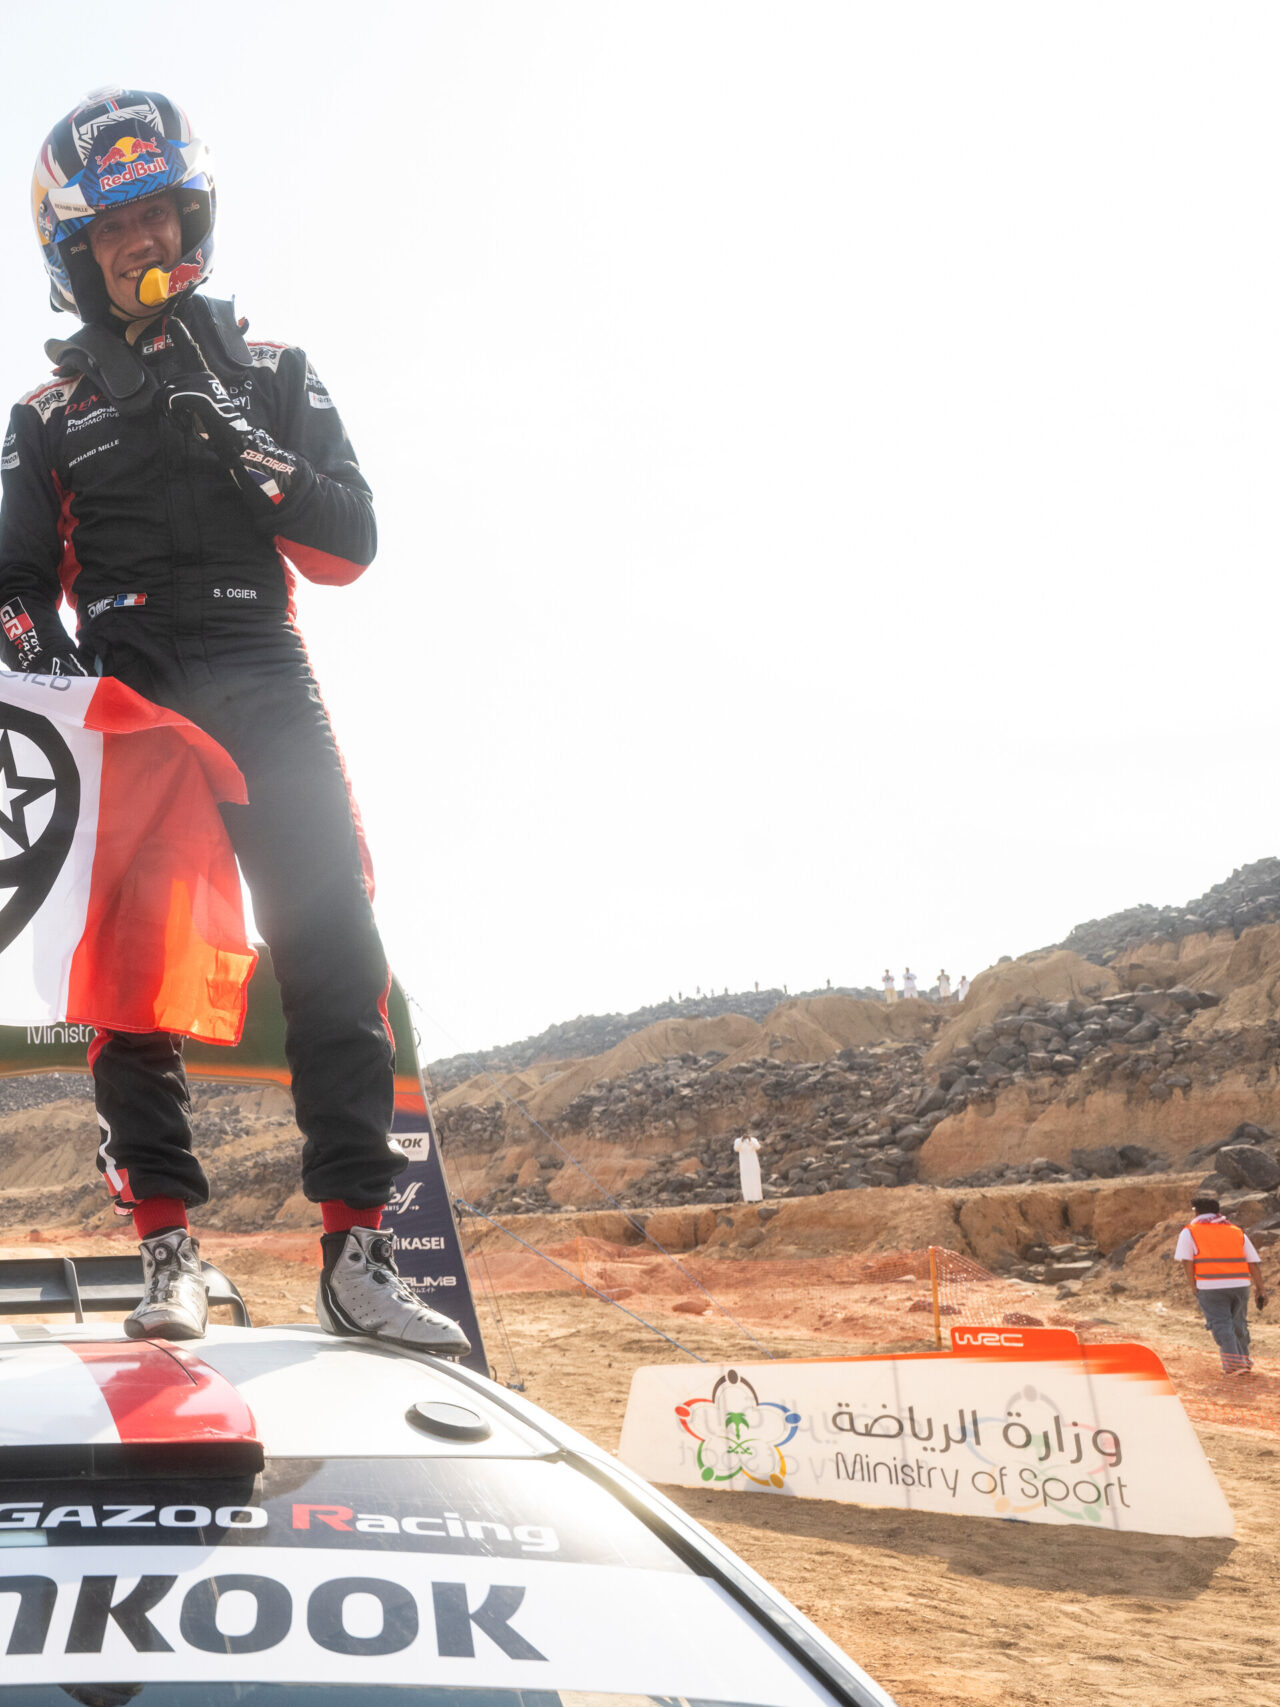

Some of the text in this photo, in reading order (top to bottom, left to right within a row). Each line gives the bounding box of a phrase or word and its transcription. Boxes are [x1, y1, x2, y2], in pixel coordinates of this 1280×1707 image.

[99, 157, 169, 191] Red Bull
[143, 341, 166, 355] GR
[64, 393, 102, 416] DEN
[67, 405, 118, 427] Panasonic
[68, 438, 120, 468] RICHARD MILLE
[240, 449, 264, 462] SEB
[213, 588, 258, 600] S. OGIER
[0, 605, 24, 639] GR
[27, 1024, 97, 1044] Ministr
[394, 1236, 445, 1250] iKASEI
[400, 1276, 457, 1287] RUM8
[955, 1332, 1024, 1348] WRC
[831, 1402, 1122, 1468] وزارة الرياضة
[835, 1451, 1131, 1508] Ministry of Sport
[291, 1503, 560, 1553] Racing
